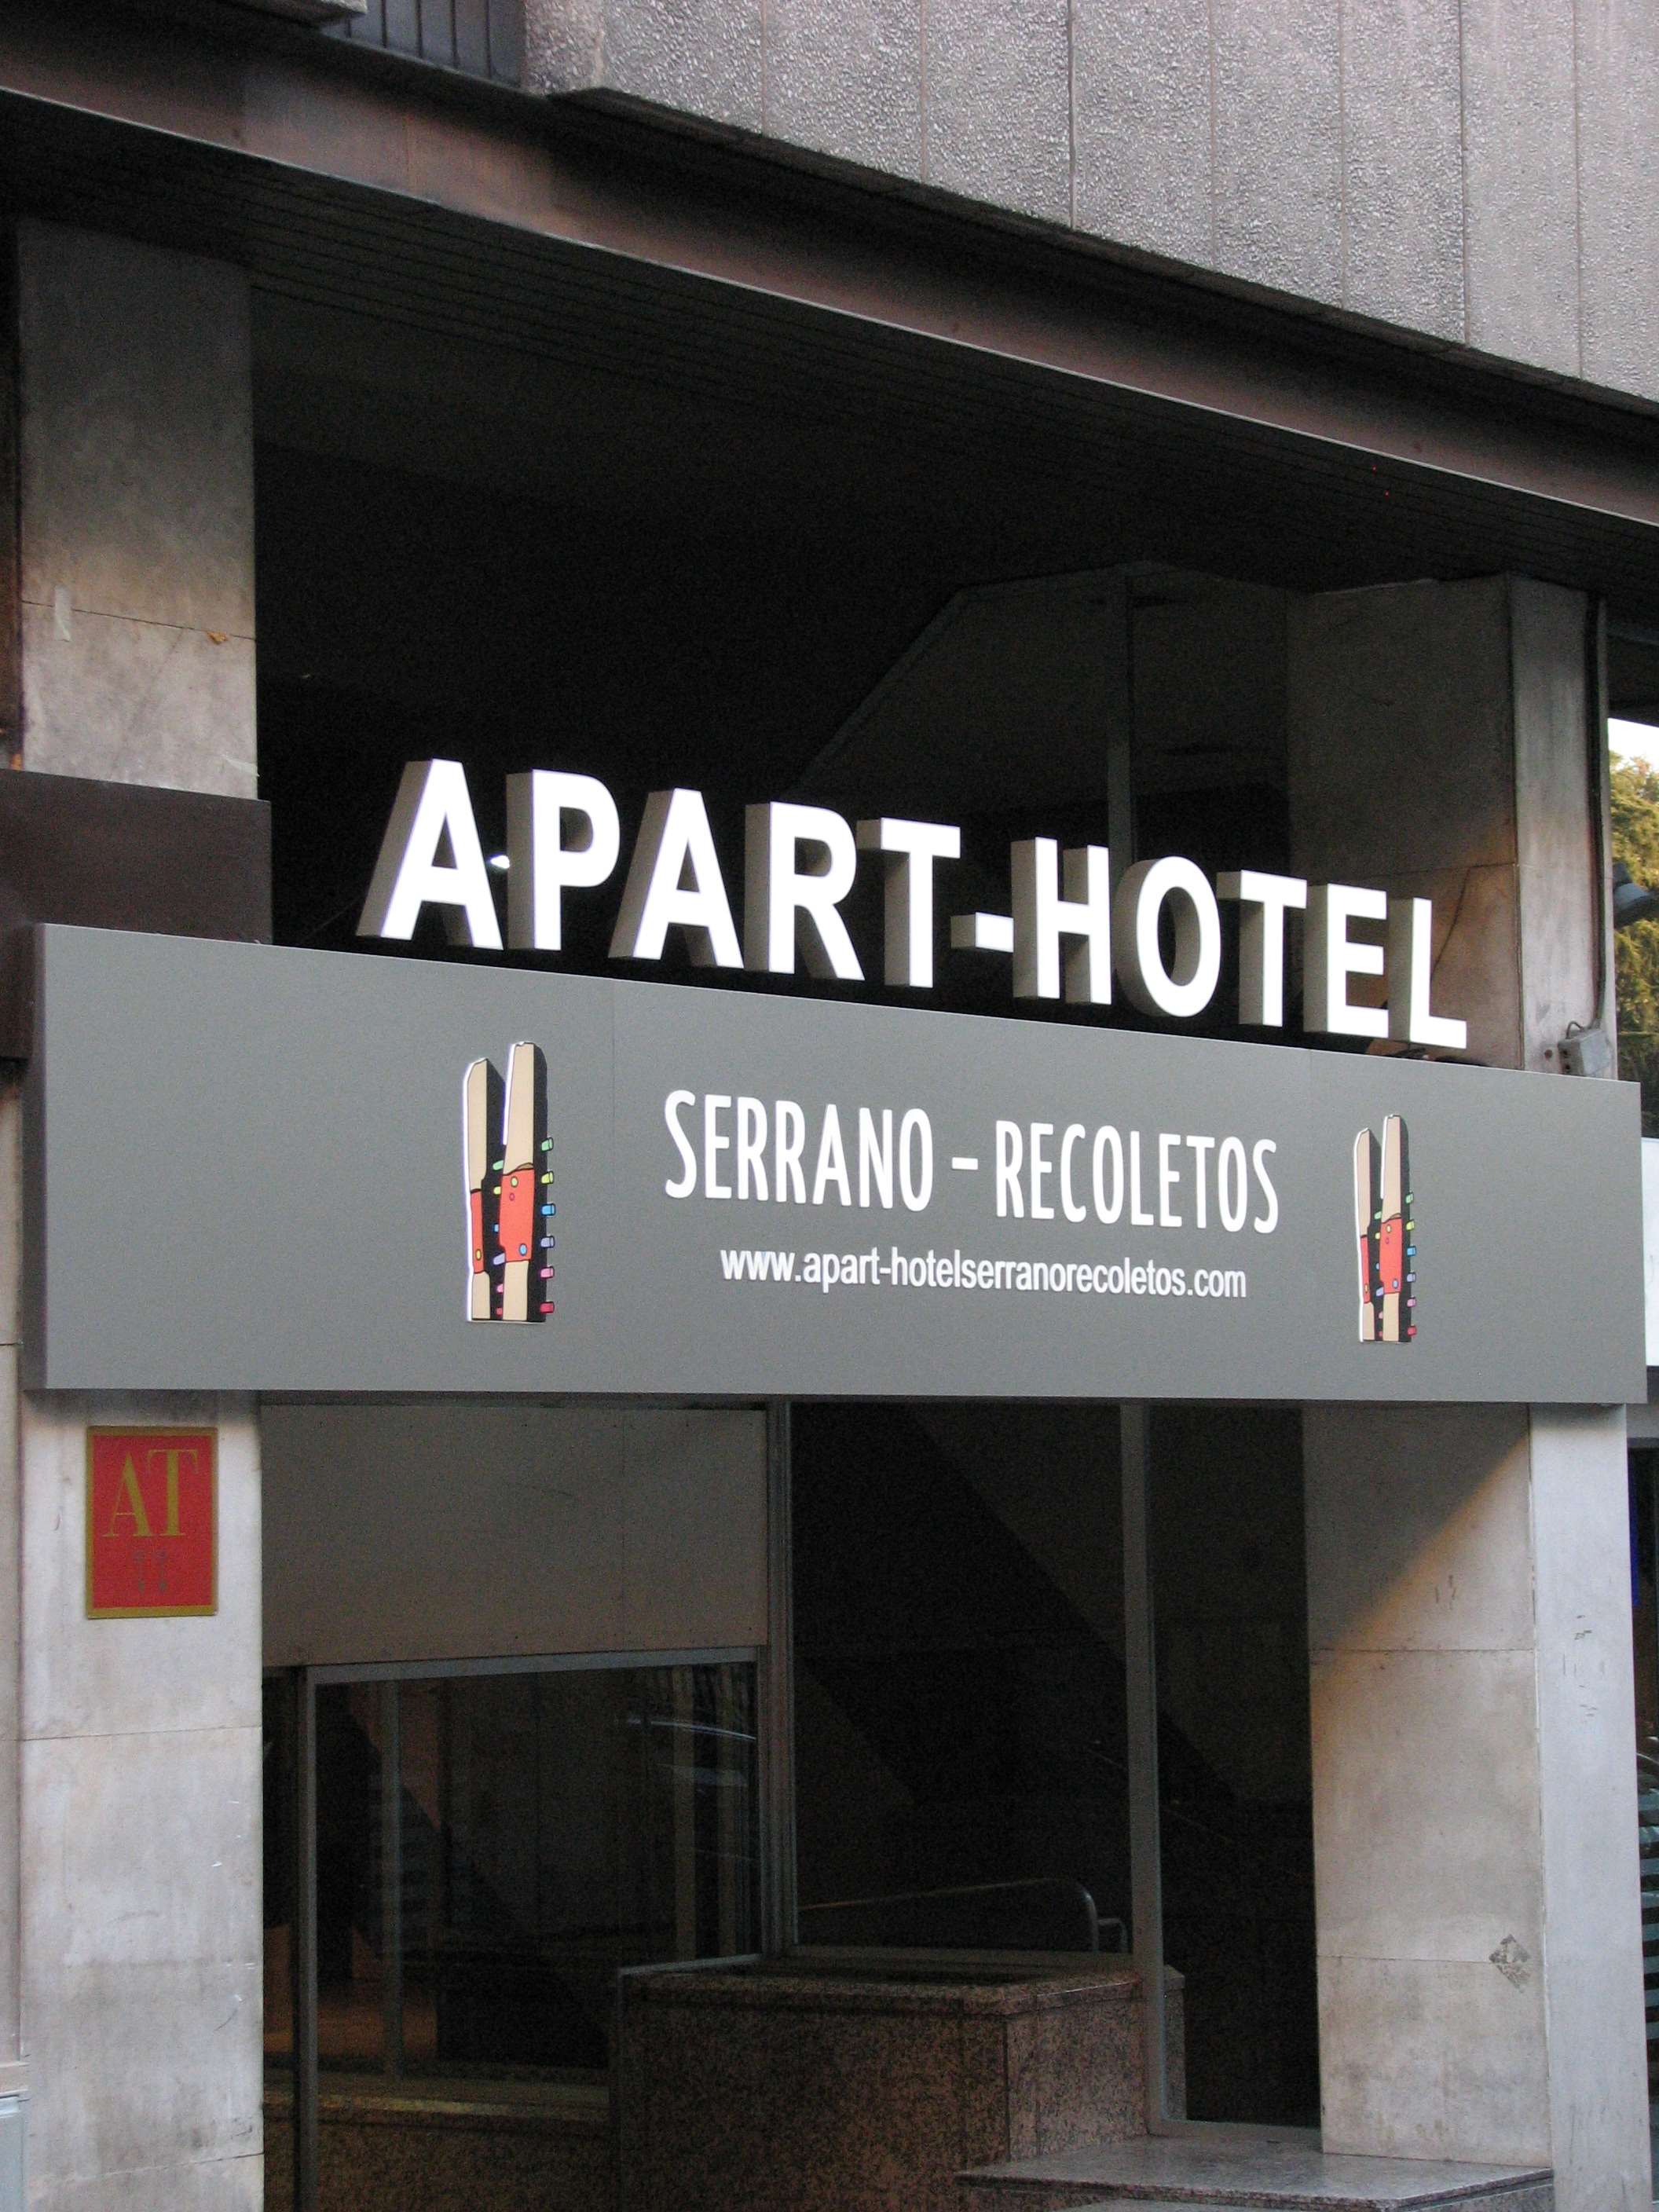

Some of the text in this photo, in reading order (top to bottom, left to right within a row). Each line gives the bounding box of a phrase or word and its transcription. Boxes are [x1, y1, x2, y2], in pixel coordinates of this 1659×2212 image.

[360, 759, 1467, 1050] APART-HOTEL
[664, 1089, 933, 1212] SERRANO
[995, 1119, 1280, 1234] RECOLETOS
[720, 1246, 1247, 1298] www.apart-hotelserranorecoletos.com
[102, 1448, 199, 1537] AT
